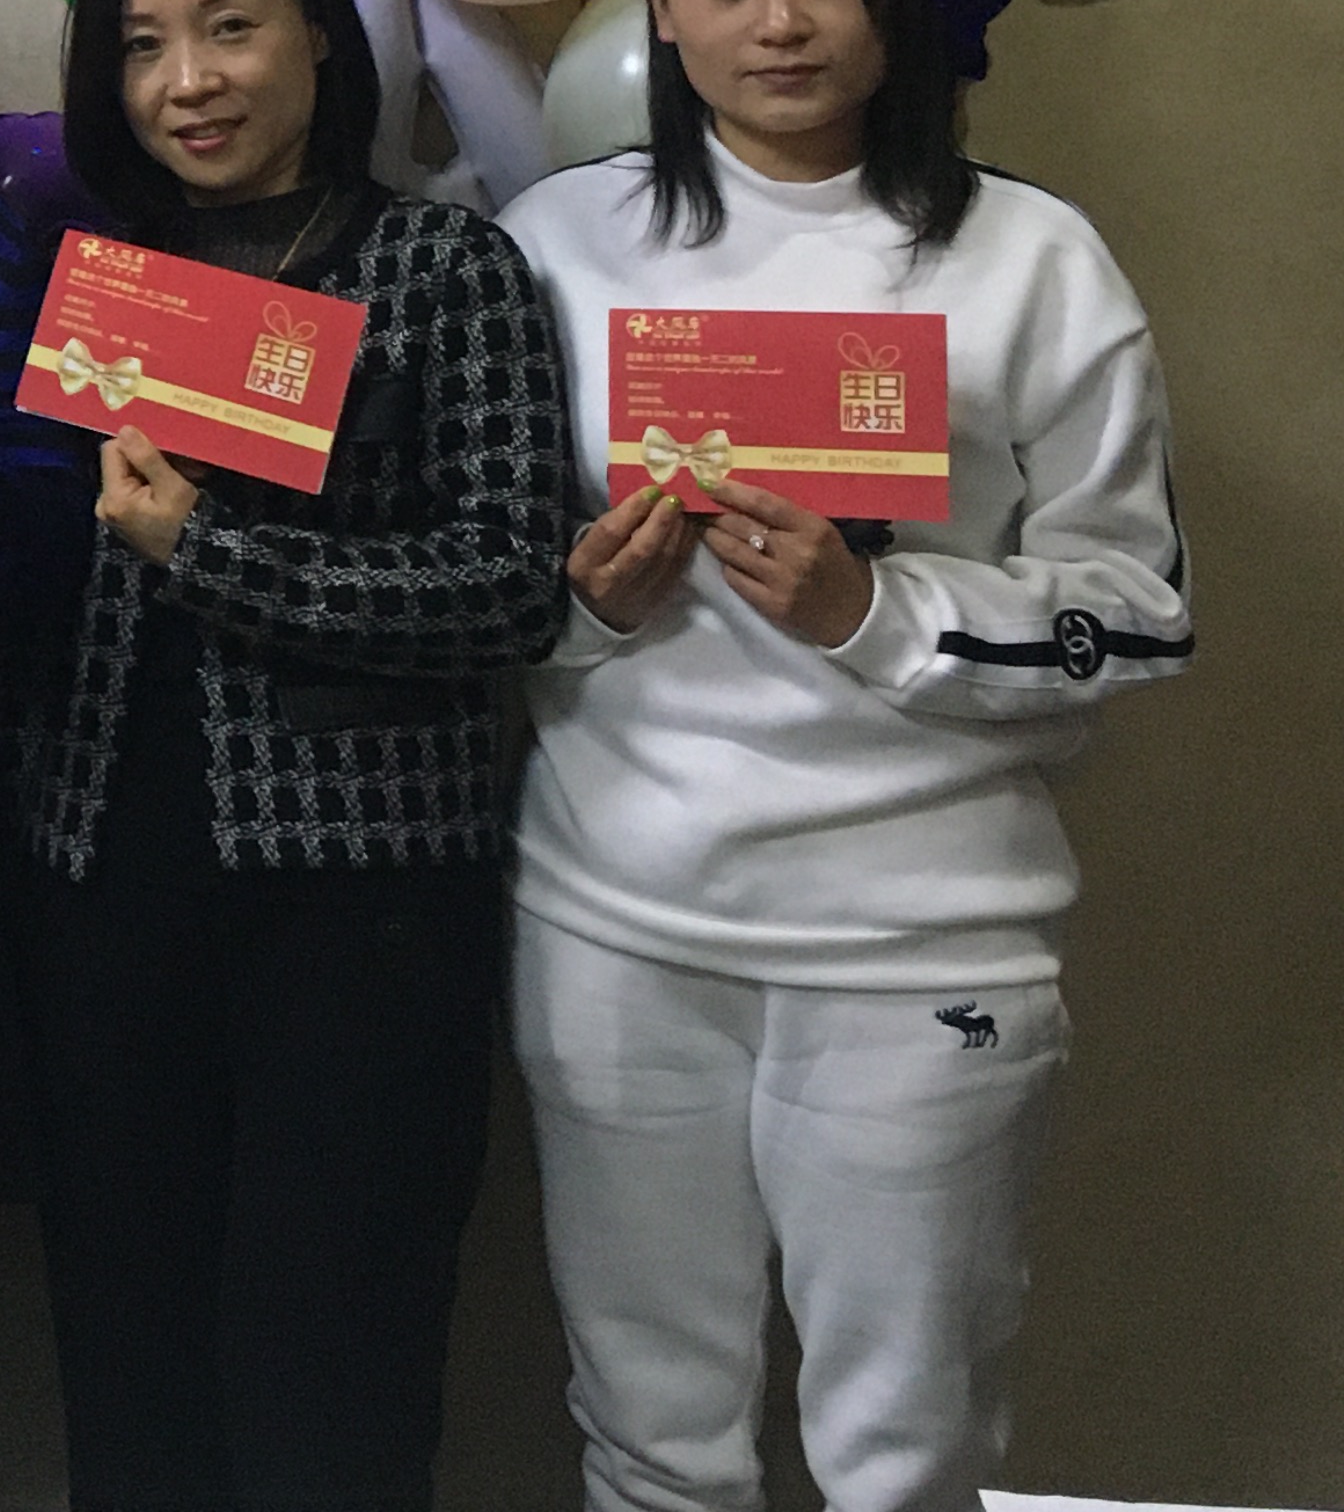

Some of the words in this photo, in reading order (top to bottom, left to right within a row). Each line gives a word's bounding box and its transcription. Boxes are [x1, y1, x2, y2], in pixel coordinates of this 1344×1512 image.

[255, 337, 313, 374] 生日
[247, 364, 306, 402] 快乐
[842, 372, 902, 400] 生日
[172, 391, 218, 414] HAPPY
[223, 407, 293, 435] BIRTHDAY
[843, 402, 903, 430] 快乐
[771, 453, 820, 467] HAPPY
[827, 454, 902, 469] BIRTHDAY
